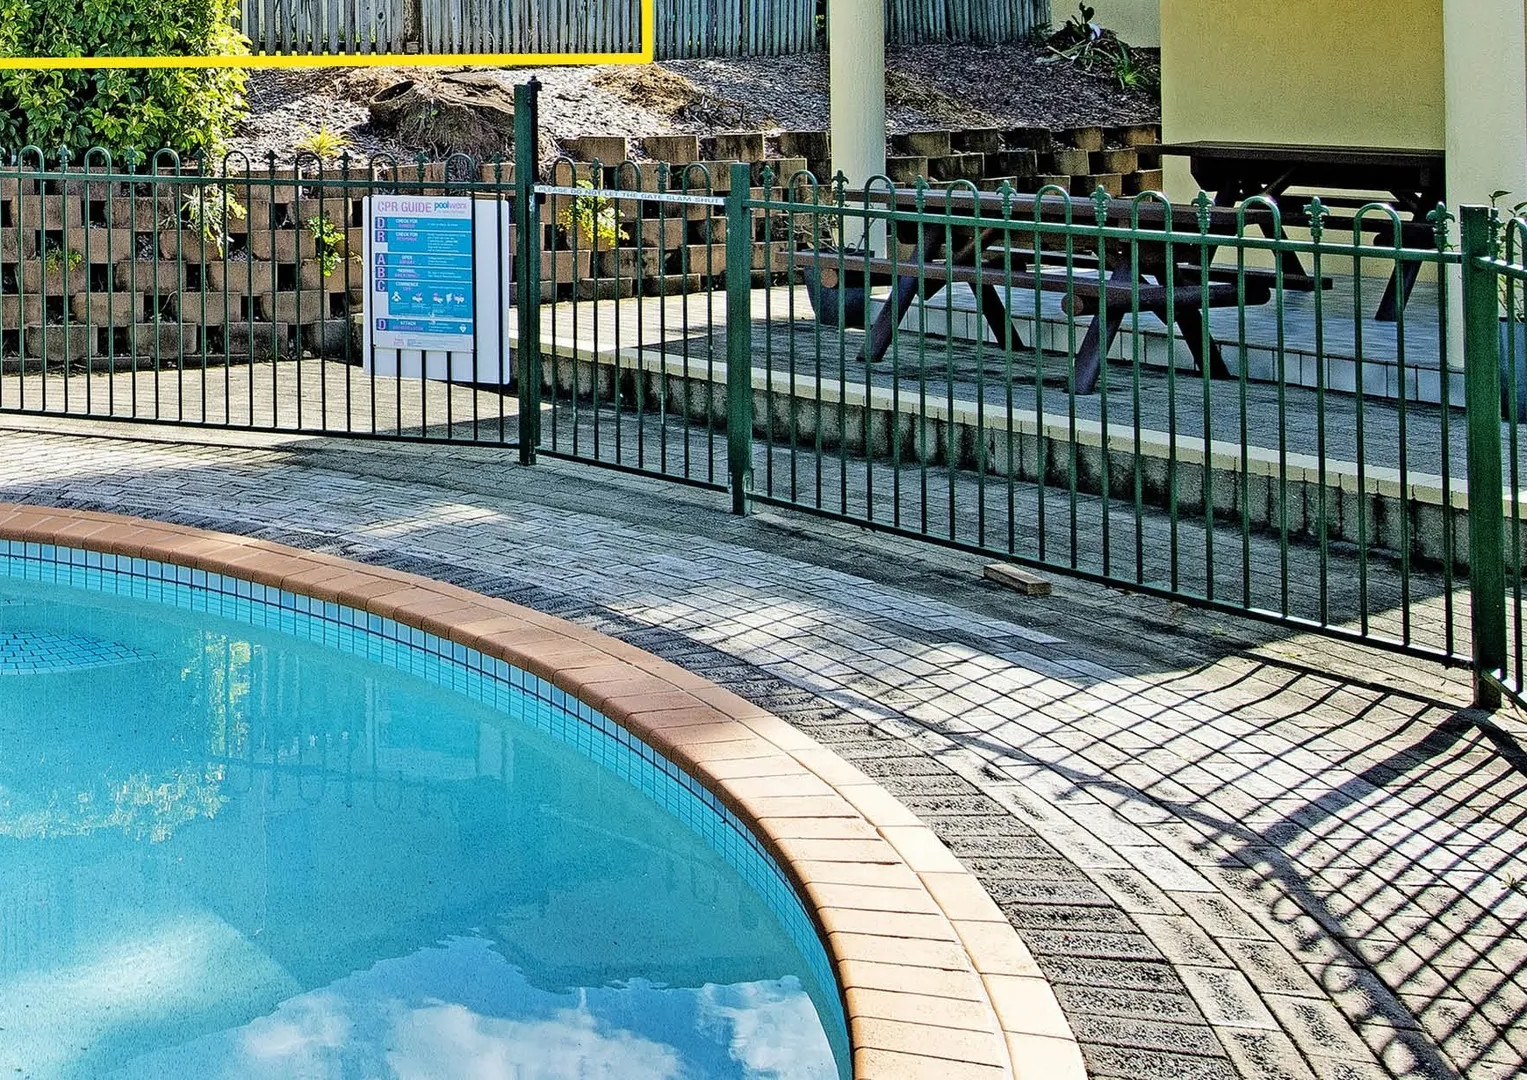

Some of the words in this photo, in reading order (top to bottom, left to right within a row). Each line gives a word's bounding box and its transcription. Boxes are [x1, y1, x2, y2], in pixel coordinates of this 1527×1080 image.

[377, 201, 398, 212] CPR
[401, 202, 431, 214] GUIDE
[377, 218, 385, 229] D
[377, 231, 385, 241] R
[377, 254, 385, 265] A
[377, 267, 385, 278] B
[377, 280, 385, 291] C
[378, 319, 386, 330] D
